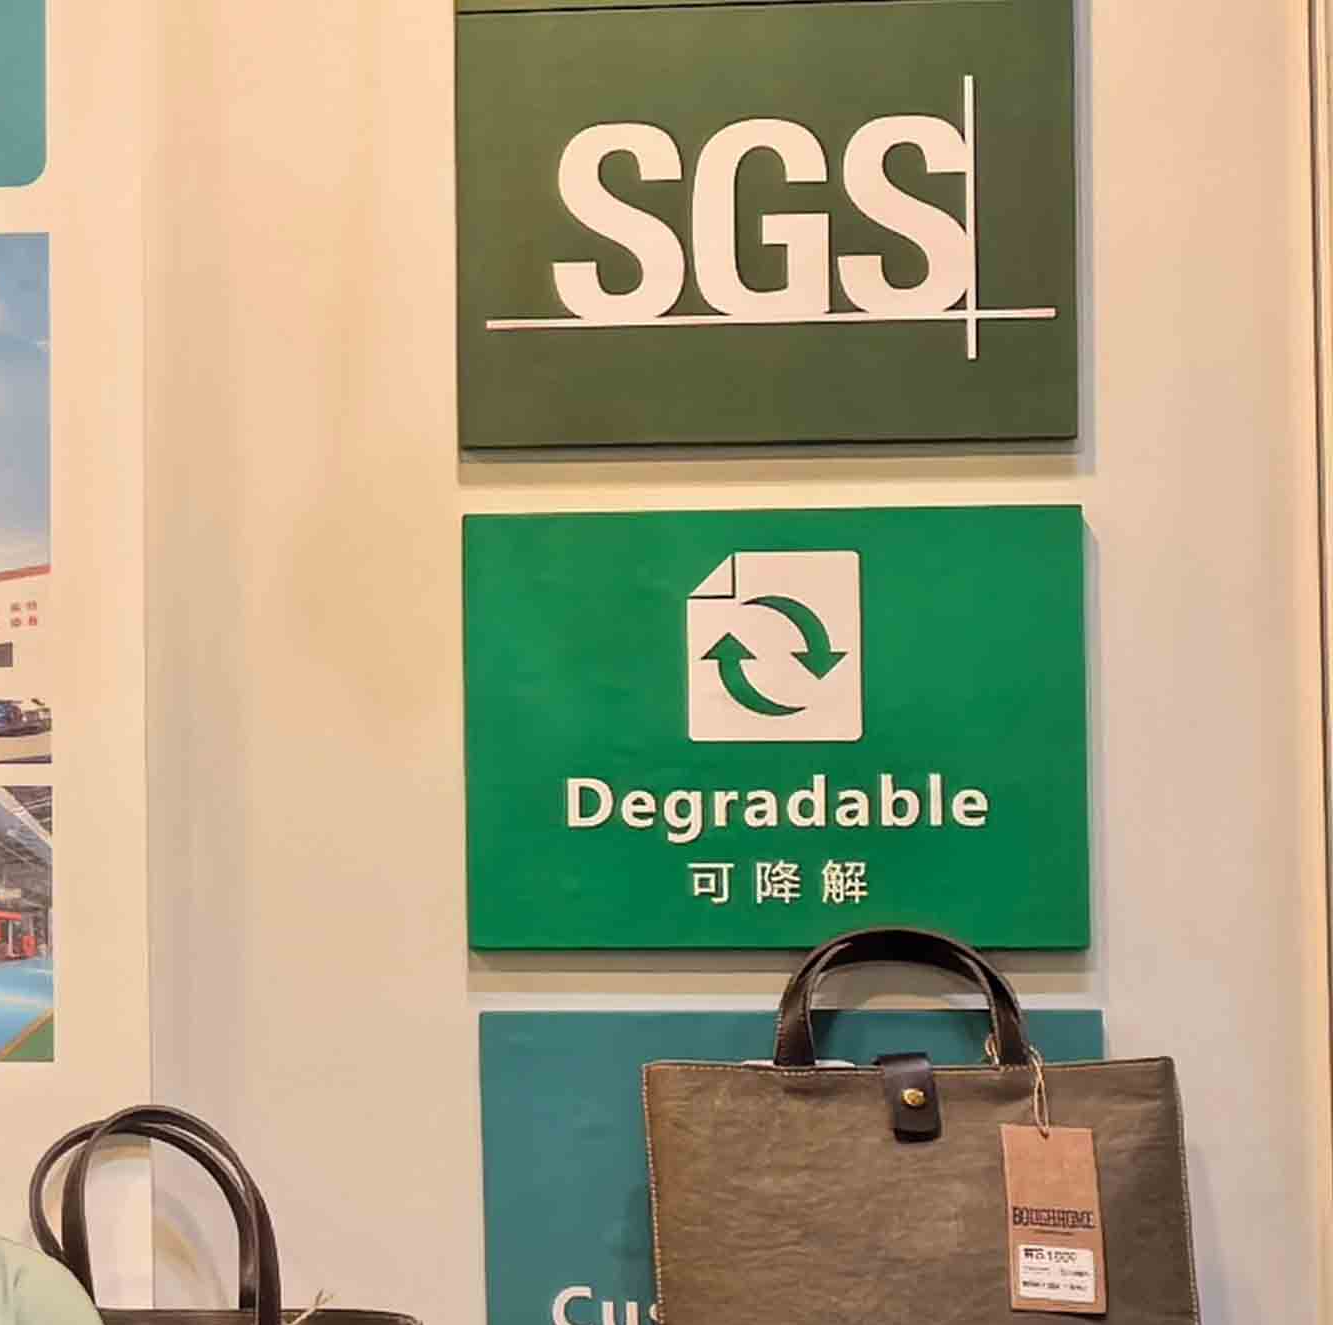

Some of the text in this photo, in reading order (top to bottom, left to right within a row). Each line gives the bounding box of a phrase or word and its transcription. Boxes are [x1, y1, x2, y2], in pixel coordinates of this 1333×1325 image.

[551, 113, 976, 322] SGS
[565, 773, 990, 843] Degradable
[687, 859, 869, 905] 可降解
